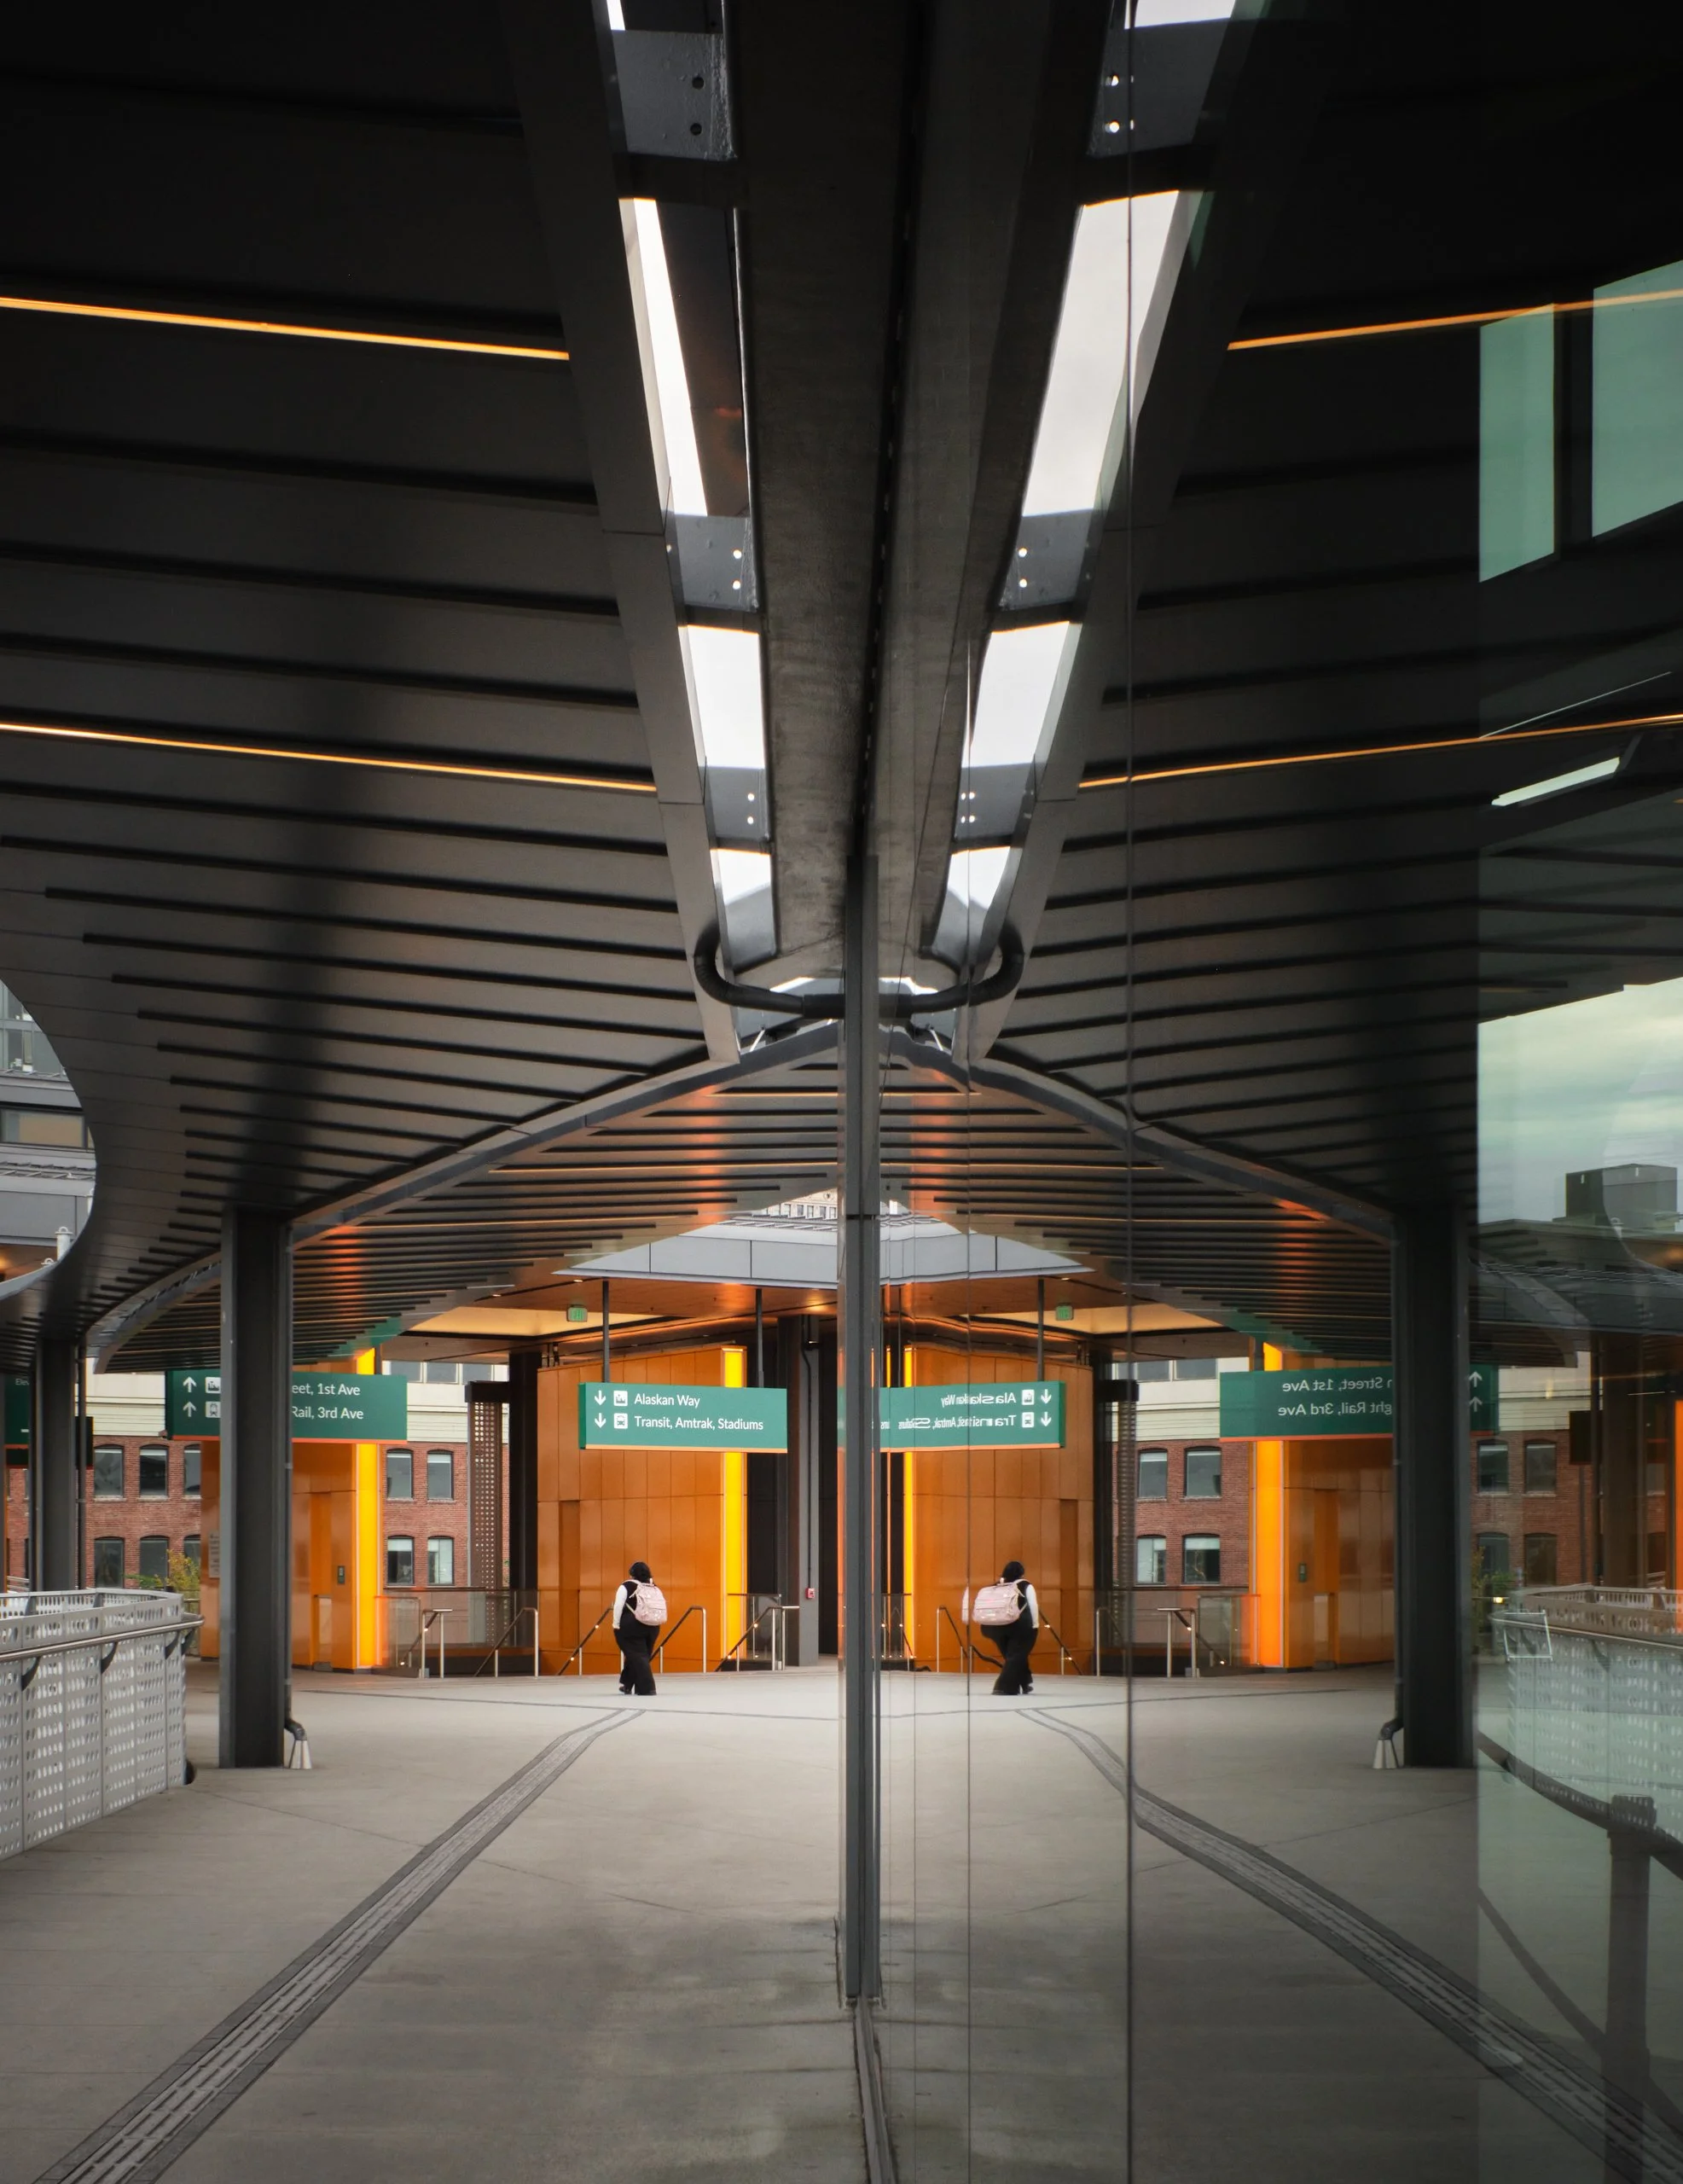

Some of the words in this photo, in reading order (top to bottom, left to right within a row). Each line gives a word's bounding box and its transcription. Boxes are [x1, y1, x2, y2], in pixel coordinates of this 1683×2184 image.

[292, 1383, 314, 1396] eet,
[317, 1383, 335, 1395] 1st
[338, 1384, 361, 1396] Ave
[635, 1393, 674, 1405] Alaskan
[676, 1395, 700, 1409] Way
[317, 1407, 337, 1419] 3rd
[340, 1408, 363, 1420] Ave
[635, 1416, 672, 1430] Transit,
[675, 1417, 715, 1431] Amtrak,
[717, 1418, 763, 1430] Stadiums
